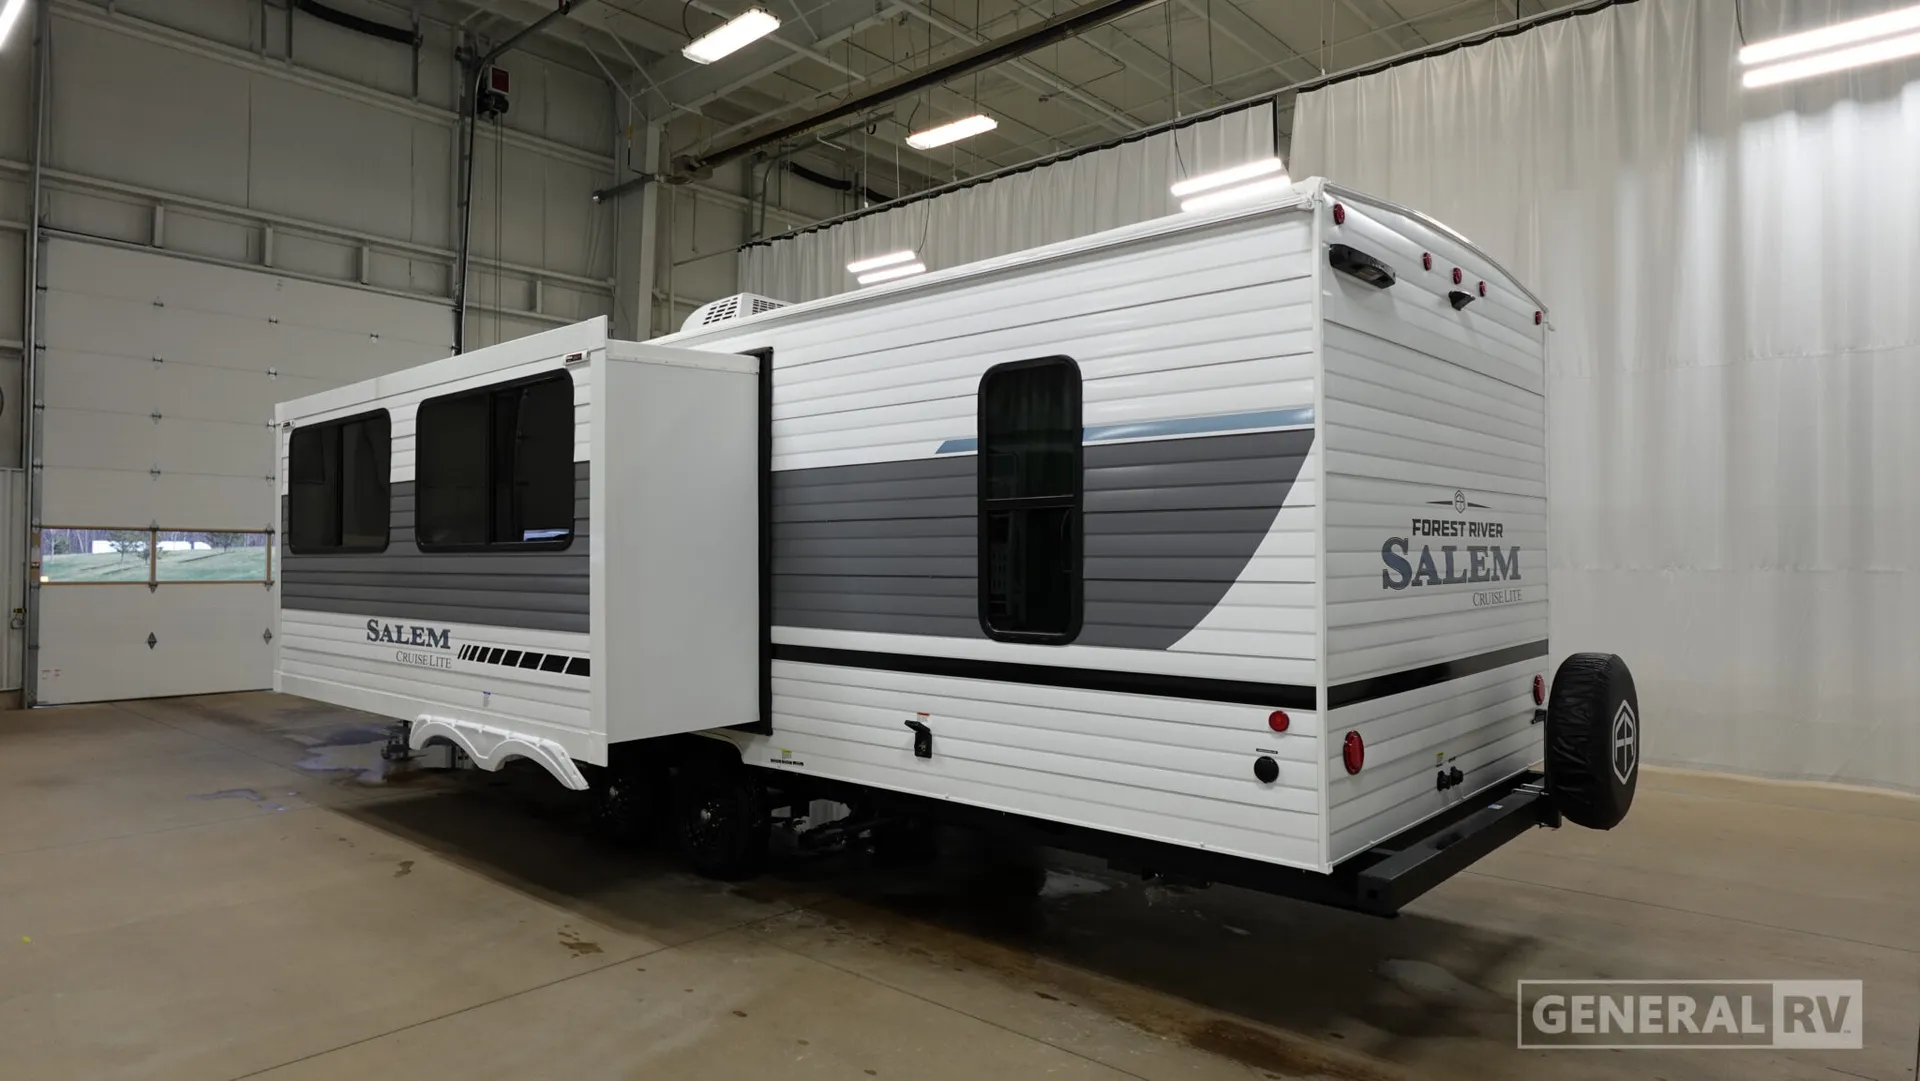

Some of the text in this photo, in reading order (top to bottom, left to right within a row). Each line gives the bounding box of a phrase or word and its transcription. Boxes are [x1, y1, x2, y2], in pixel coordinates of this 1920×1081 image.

[1412, 519, 1503, 538] FOREST RIVER
[1381, 537, 1521, 590] SALEM
[366, 618, 451, 650] SALEM
